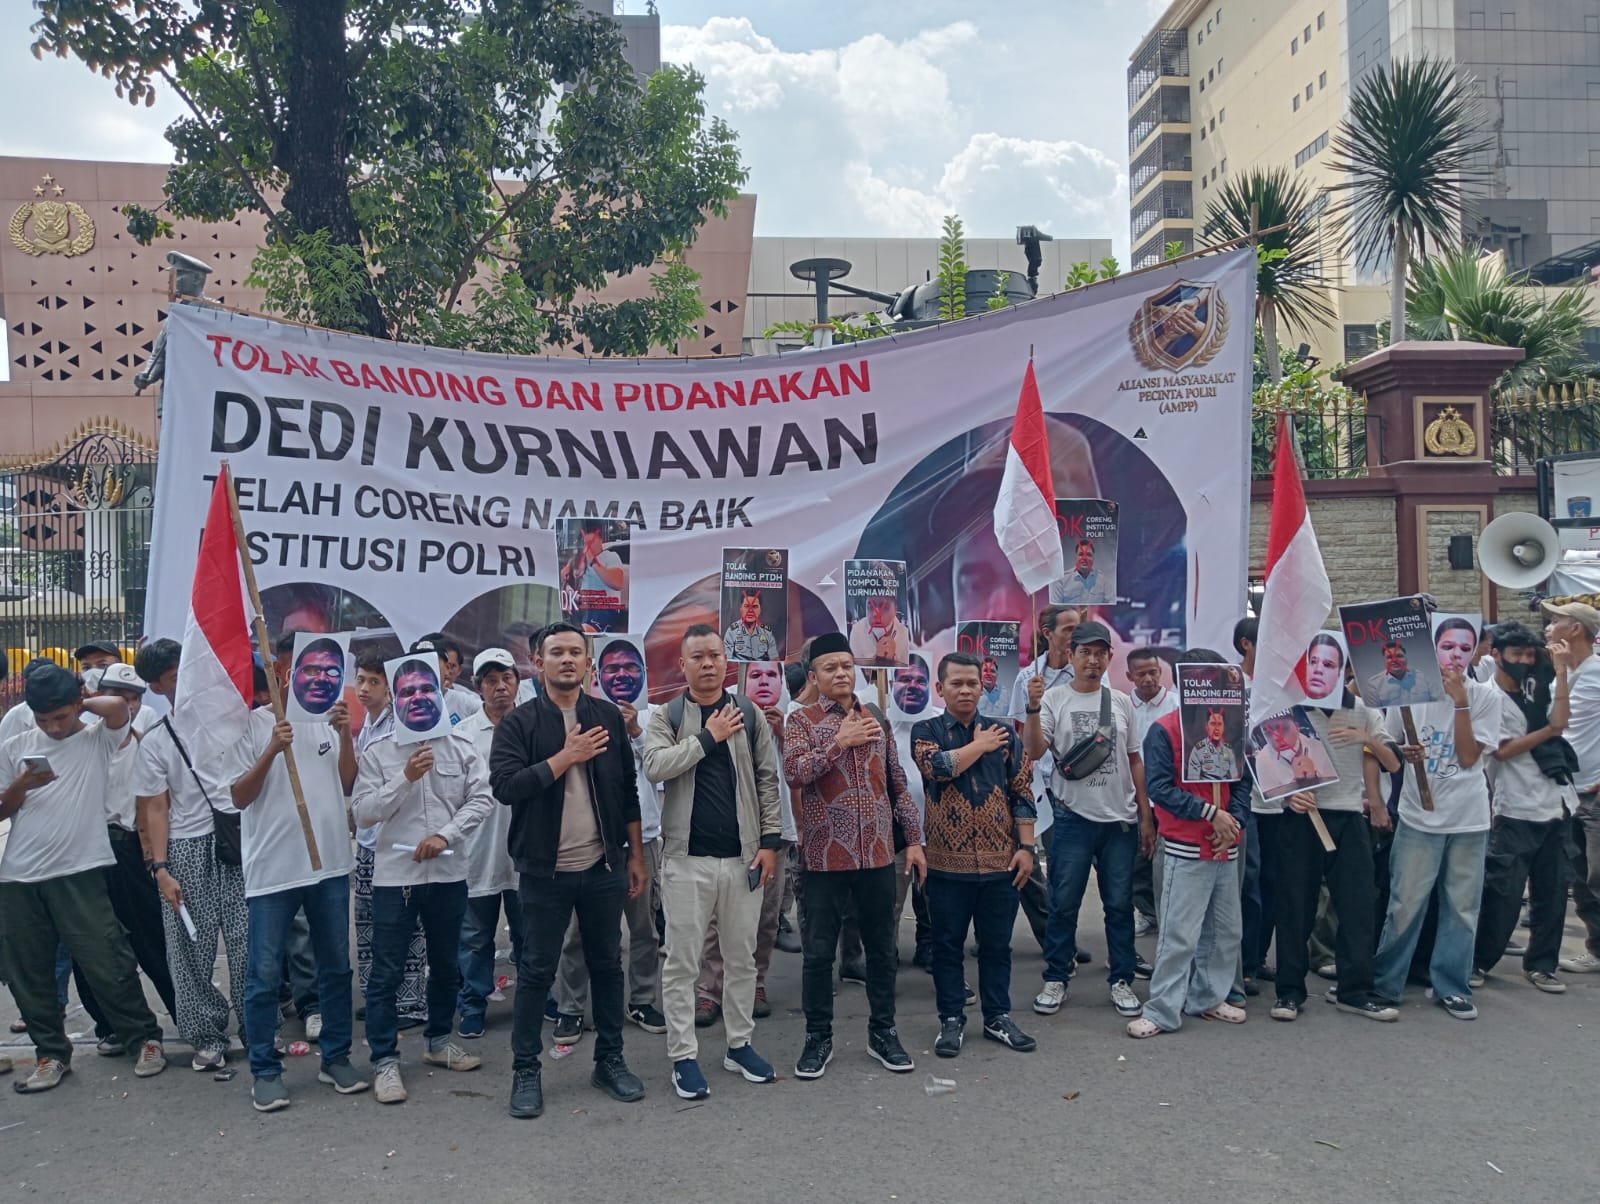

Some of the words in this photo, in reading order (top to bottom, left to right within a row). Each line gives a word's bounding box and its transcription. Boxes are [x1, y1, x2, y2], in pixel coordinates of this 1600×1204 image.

[206, 334, 333, 382] TOLAK
[330, 359, 507, 406] BANDING
[515, 377, 604, 412] DAN
[614, 360, 872, 412] PIDANAKAN
[1117, 376, 1161, 392] ALIANSI
[1163, 372, 1237, 389] MASYARAKAT
[1138, 389, 1183, 402] PECINTA
[1185, 386, 1217, 399] POLRI
[1159, 400, 1199, 415] (AMPP)
[210, 390, 381, 466] DEDI
[405, 411, 879, 480] KURNIAWAN
[354, 484, 511, 529] CORENG
[659, 496, 755, 531] BAIK
[200, 528, 406, 572] STITUSI
[419, 540, 536, 577] POLRI
[725, 562, 747, 570] TOLAK
[847, 569, 894, 577] PIDANAKAN
[725, 572, 757, 581] BANDING
[759, 573, 783, 581] PTDH
[847, 578, 882, 587] KOMPOL
[883, 579, 900, 588] DEDI
[561, 590, 579, 610] DK
[847, 588, 896, 597] KURNIAWAN
[1345, 617, 1390, 646] DK
[1387, 615, 1420, 625] CORENG
[1388, 622, 1427, 633] INSTITUSI
[1390, 631, 1414, 640] POLRI
[959, 635, 989, 656] DK
[1183, 679, 1212, 687] TOLAK
[1183, 689, 1221, 697] BANDING
[1222, 690, 1242, 698] PTDH
